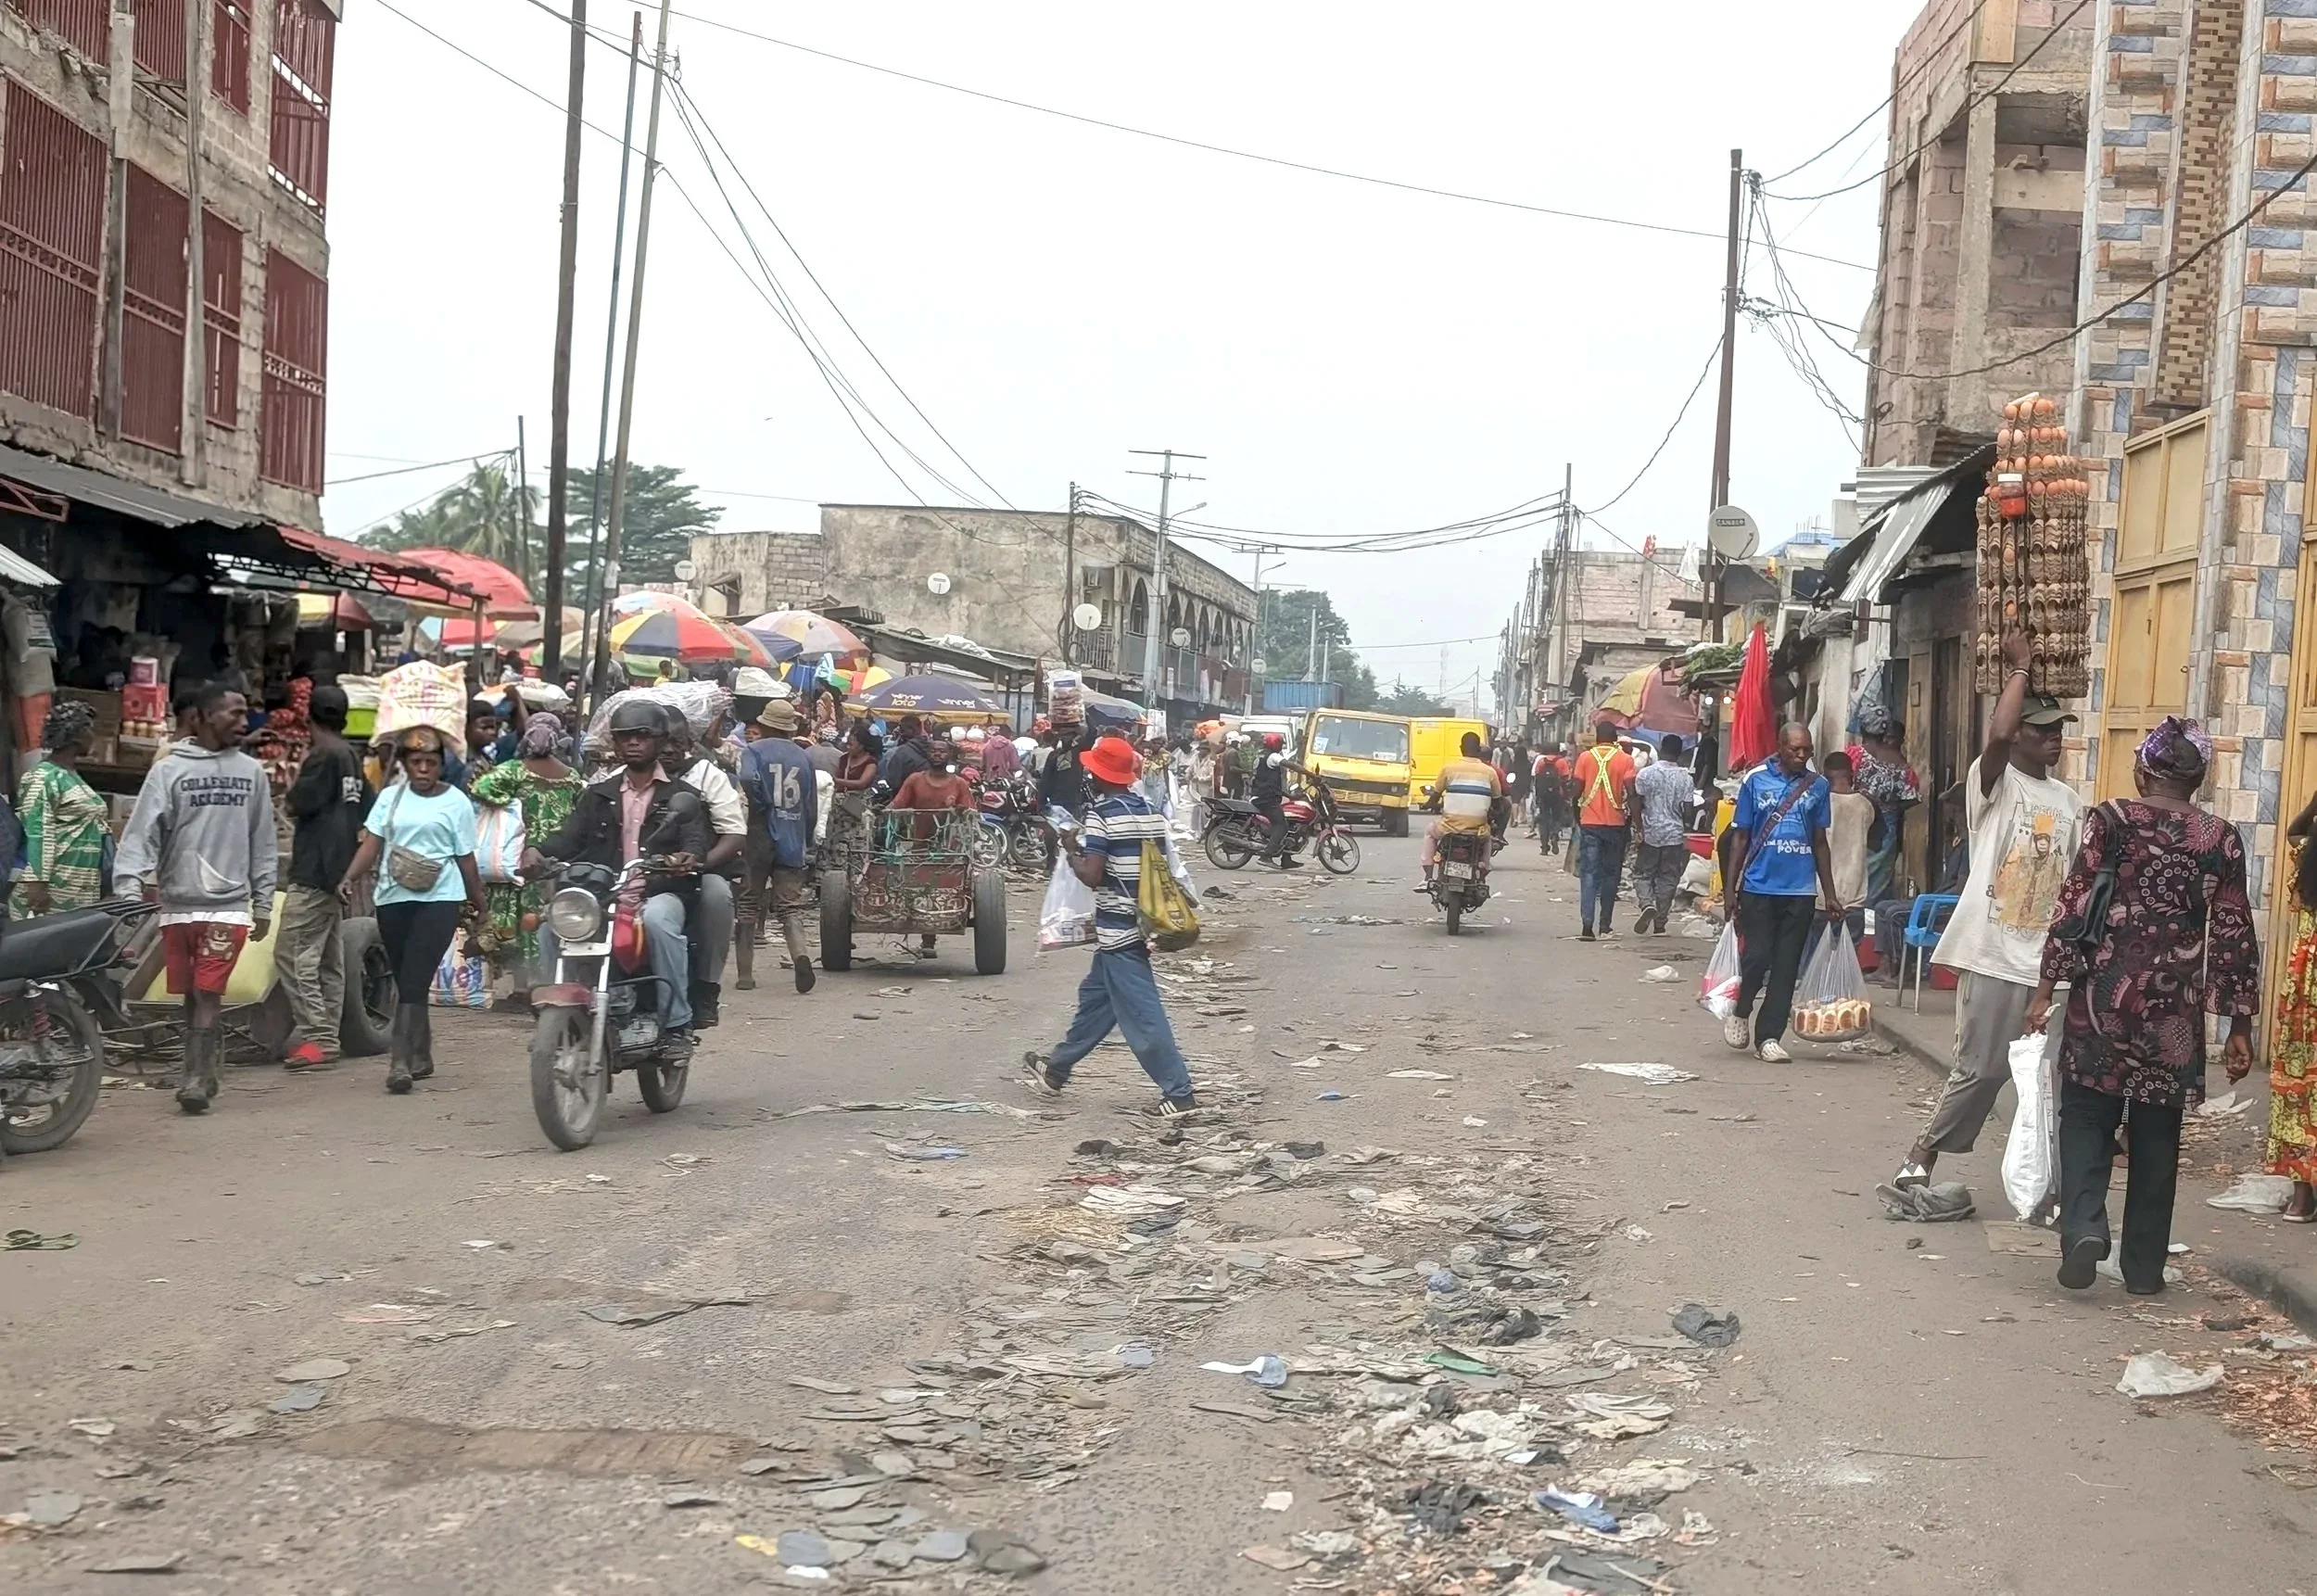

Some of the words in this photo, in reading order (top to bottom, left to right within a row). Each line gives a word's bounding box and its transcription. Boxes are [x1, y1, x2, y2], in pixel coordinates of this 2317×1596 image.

[768, 763, 801, 809] 16
[189, 792, 246, 807] ACADEMY
[1777, 845, 1813, 855] POWER
